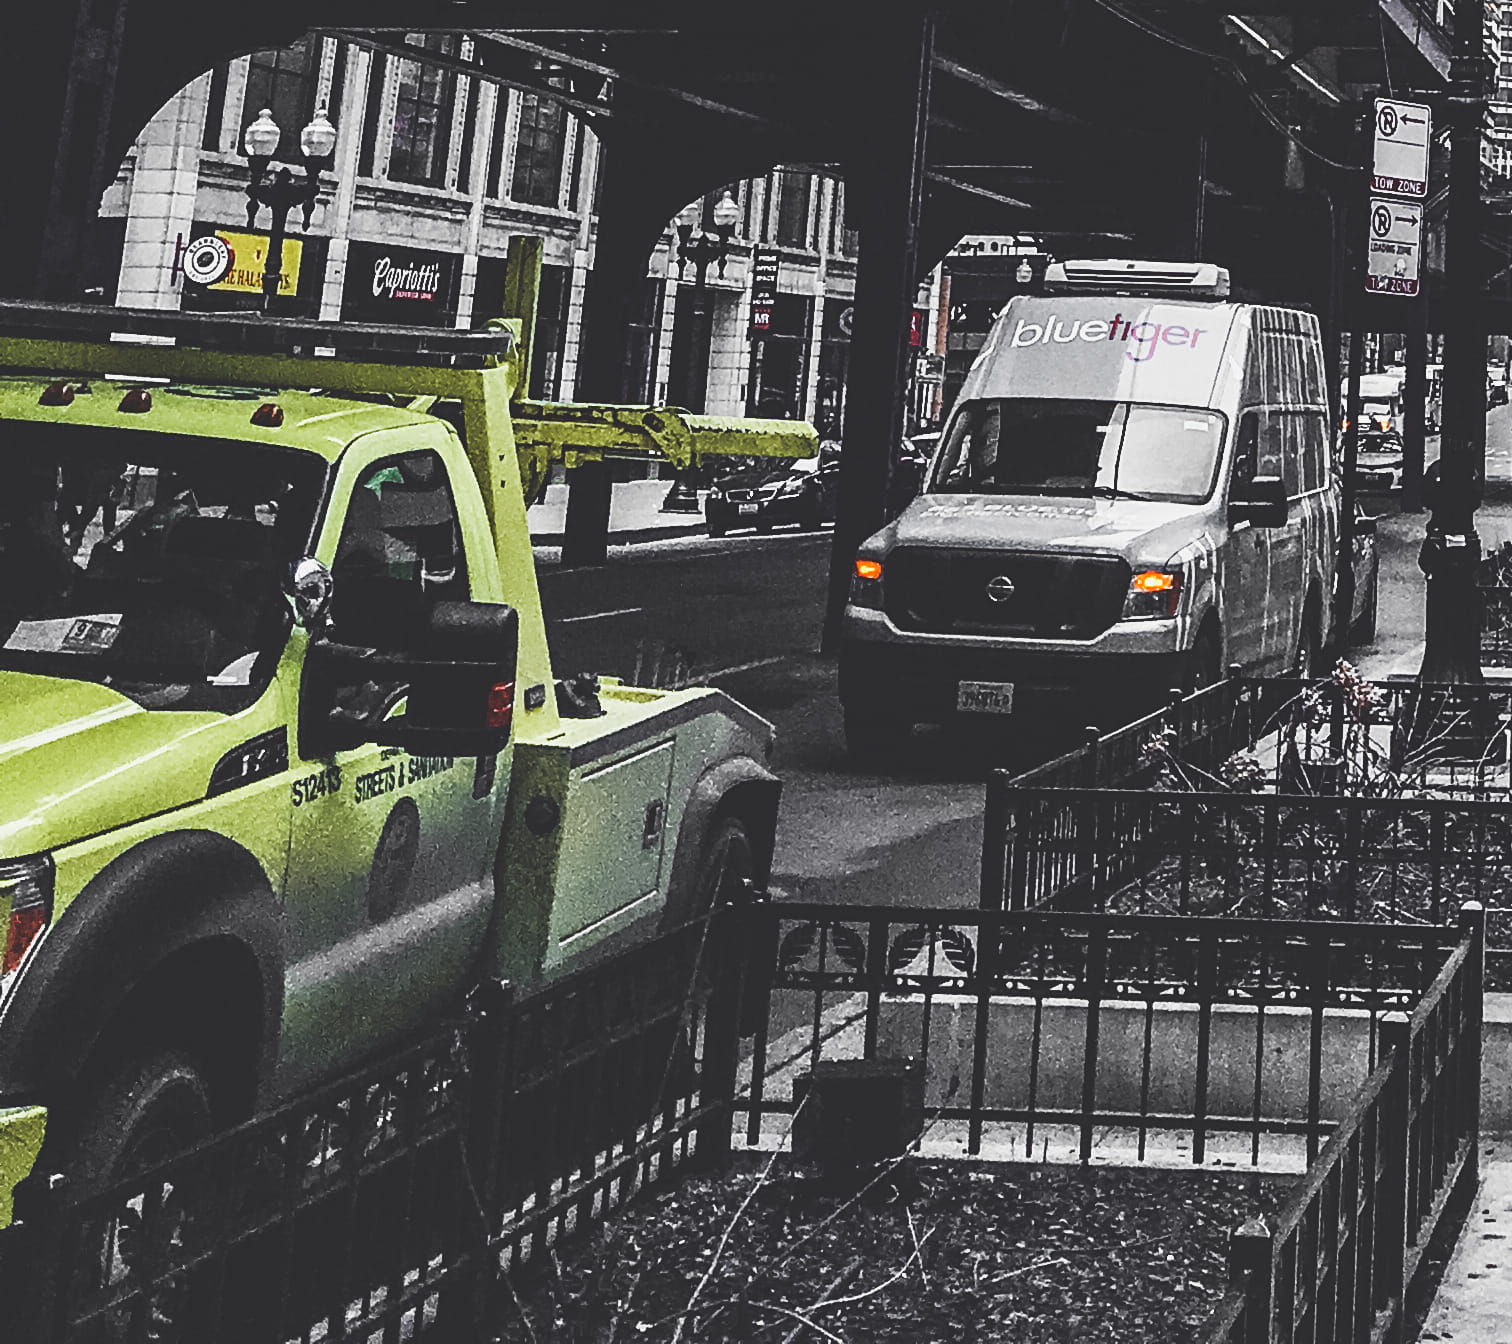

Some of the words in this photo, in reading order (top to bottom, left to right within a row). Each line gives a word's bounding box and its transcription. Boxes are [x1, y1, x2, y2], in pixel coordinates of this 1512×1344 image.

[1374, 176, 1394, 189] TOW
[1397, 180, 1422, 193] ZONE
[373, 257, 440, 298] Capriotti's
[1391, 280, 1413, 292] ZONE
[1010, 313, 1208, 362] bluetiger
[292, 765, 343, 807] S12413
[355, 764, 396, 804] STREETS
